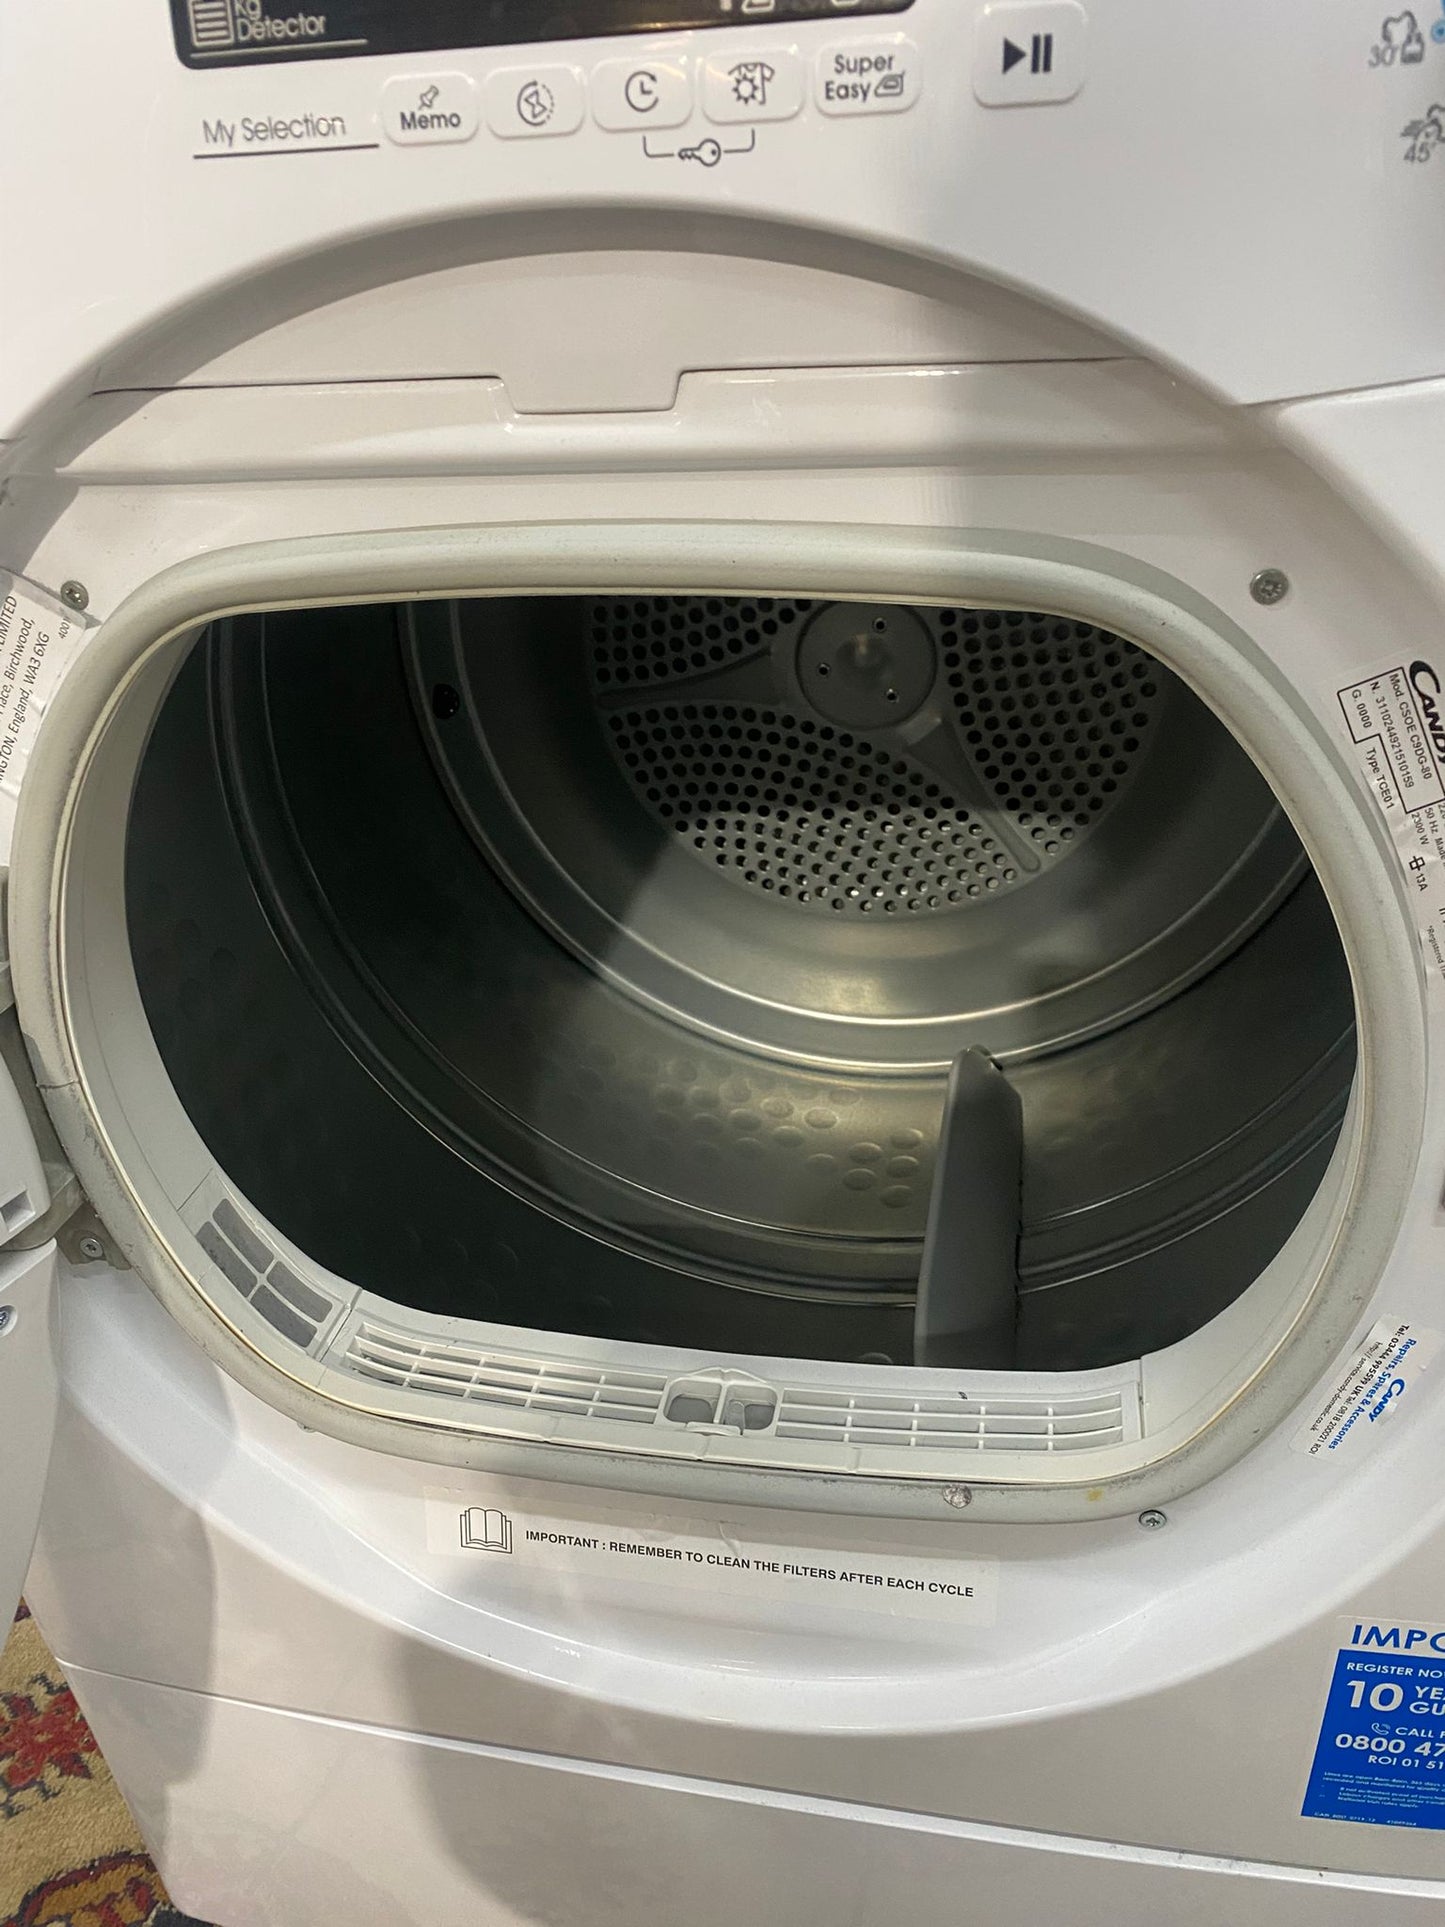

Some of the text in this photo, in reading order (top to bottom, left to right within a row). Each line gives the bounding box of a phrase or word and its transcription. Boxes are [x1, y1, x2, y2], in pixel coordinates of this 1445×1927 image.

[237, 12, 326, 40] Detector
[834, 53, 895, 76] Super
[824, 80, 871, 103] Easy
[203, 112, 346, 147] My Selection
[400, 111, 461, 130] Memo
[0, 617, 36, 715] lace, Birchwood,
[8, 687, 34, 733] England,
[23, 656, 41, 685] WA3
[33, 631, 50, 657] 6XG
[1370, 681, 1382, 695] N.
[1352, 689, 1373, 729] G. 0000
[1389, 673, 1433, 780] Mod. CSOE C9DG-80
[1365, 747, 1396, 809] Type TCE01
[1424, 807, 1436, 819] 50
[1411, 812, 1430, 845] 2300 W
[1429, 820, 1439, 834] Hz
[1416, 873, 1429, 892] 13A
[1395, 1324, 1410, 1336] Tel:
[1379, 1337, 1399, 1360] 03444
[1361, 1360, 1382, 1385] 995599
[1328, 1338, 1417, 1449] Repairs, Spares & Accessories
[1351, 1383, 1364, 1397] UK
[1368, 1378, 1406, 1422] CANDY
[1333, 1404, 1348, 1422] 0818
[1309, 1443, 1321, 1455] ROI
[526, 1530, 600, 1549] IMPORTANT
[609, 1541, 682, 1560] REMEMBER
[686, 1551, 703, 1563] TO
[707, 1554, 750, 1569] CLEAN
[754, 1560, 780, 1573] THE
[783, 1564, 836, 1580] FILTERS
[840, 1571, 883, 1586] AFTER
[887, 1577, 925, 1591] EACH
[928, 1582, 974, 1597] CYCLE
[1346, 1662, 1445, 1679] REGISTER NO
[1346, 1680, 1445, 1712] 10 YE
[1395, 1727, 1434, 1738] CALL
[1335, 1733, 1445, 1757] 0800 47
[1368, 1755, 1444, 1770] ROI 01 51
